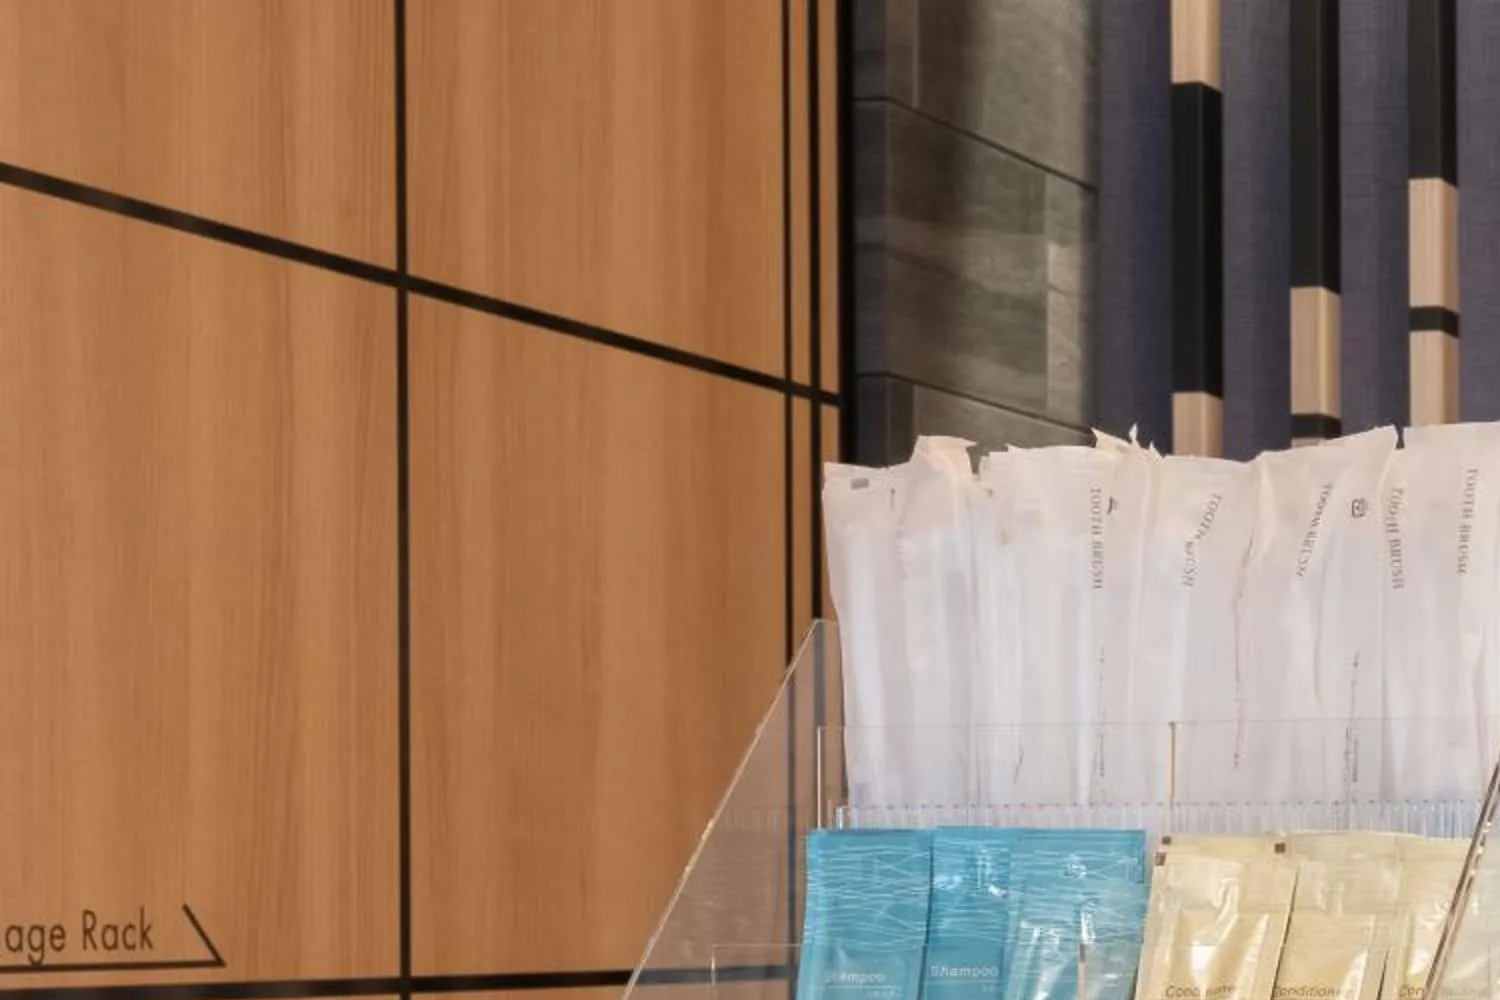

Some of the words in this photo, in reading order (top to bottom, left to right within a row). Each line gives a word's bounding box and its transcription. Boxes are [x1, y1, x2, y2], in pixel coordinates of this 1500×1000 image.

[4, 924, 67, 964] age
[82, 906, 153, 950] Rack
[824, 970, 886, 985] ampoo
[930, 964, 999, 979] Shampoo
